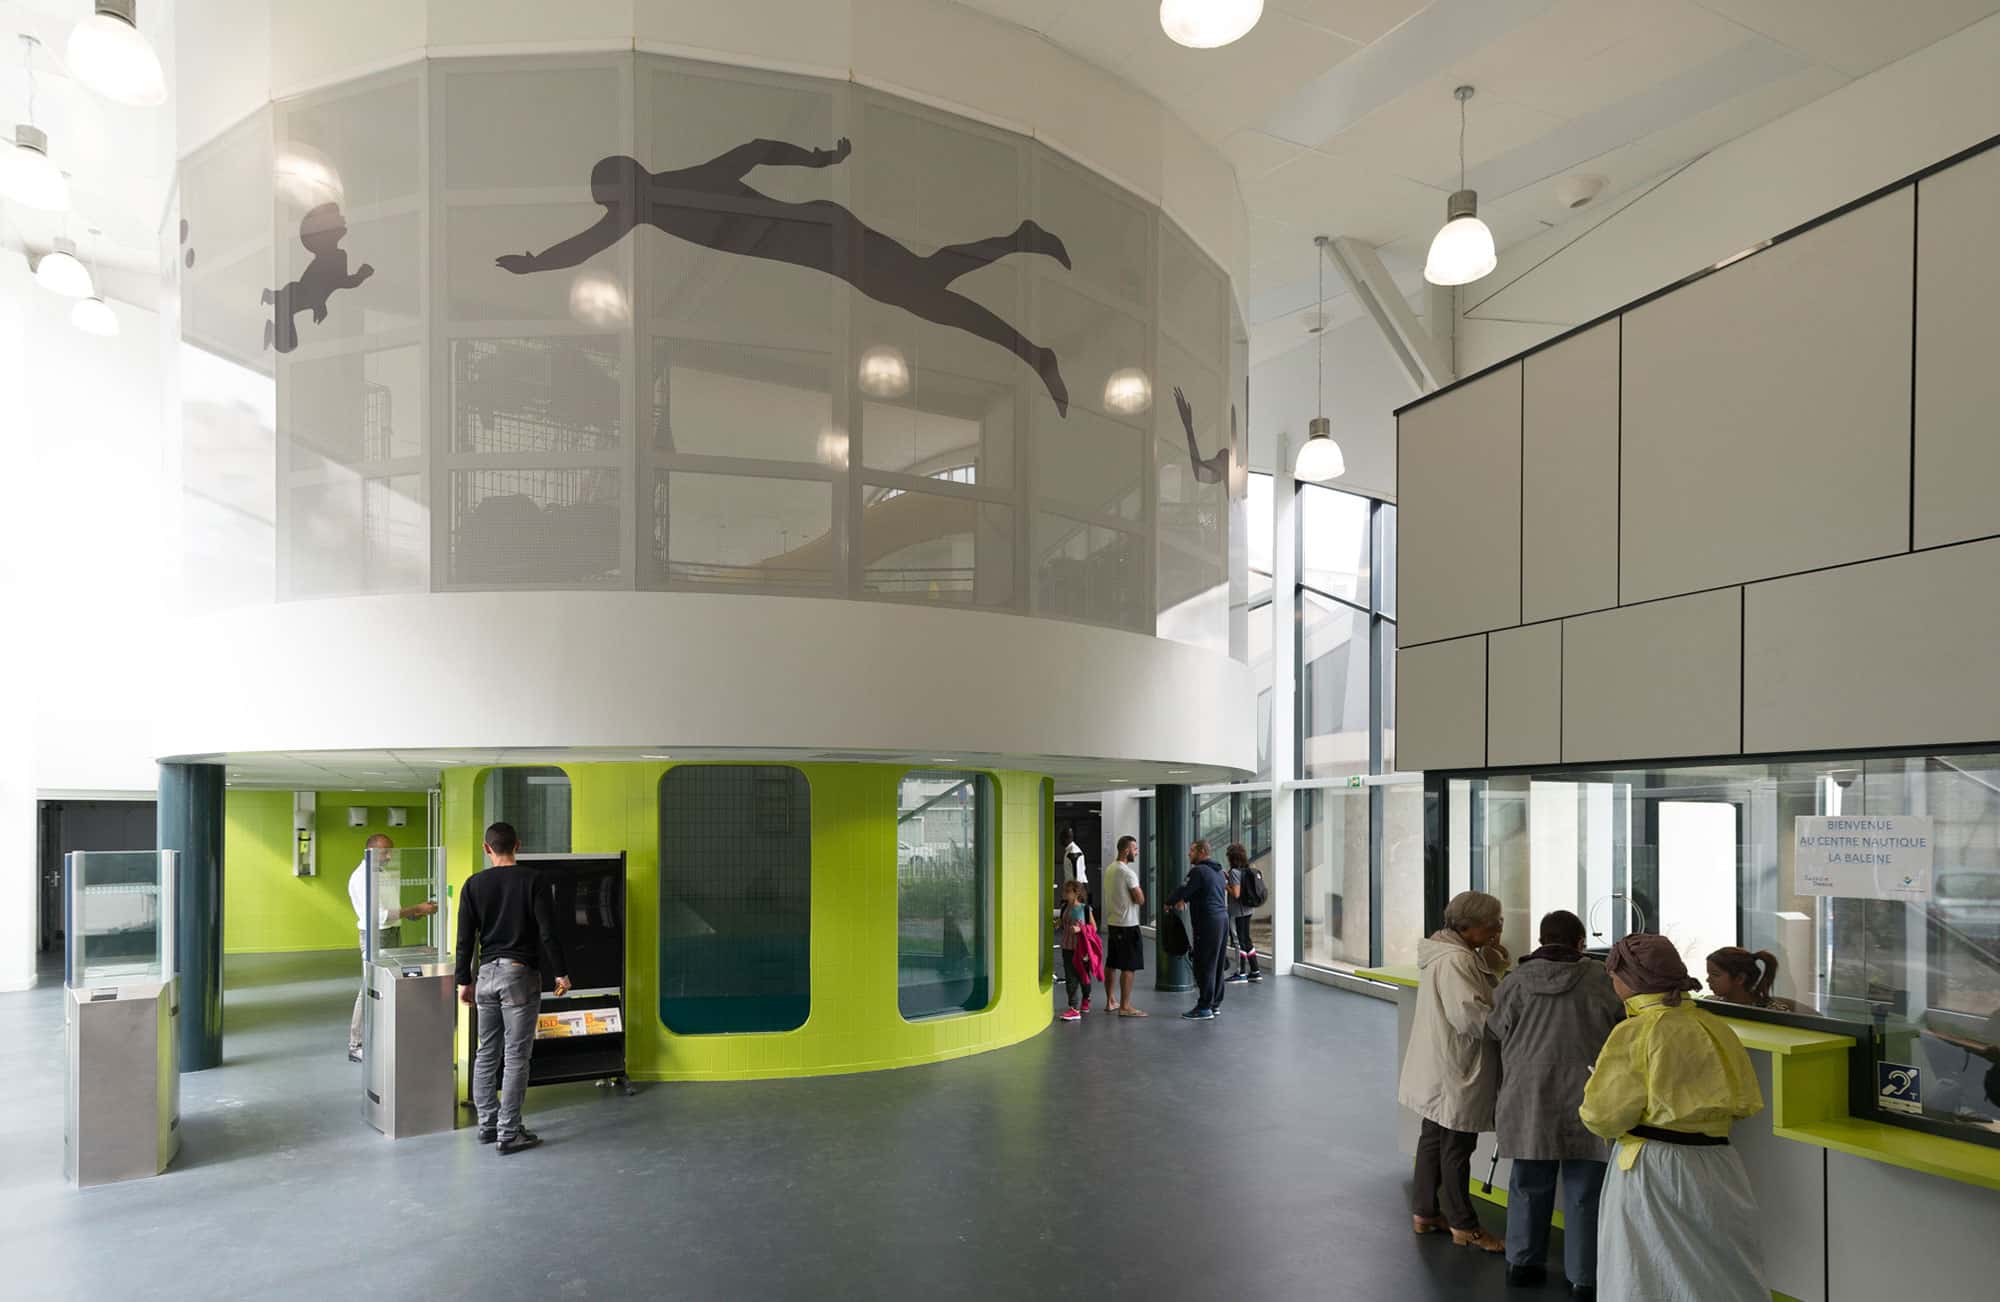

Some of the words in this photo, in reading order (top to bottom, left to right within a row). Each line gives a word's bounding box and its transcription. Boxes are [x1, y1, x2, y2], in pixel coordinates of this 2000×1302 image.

[1827, 820, 1893, 830] BIENVENUE
[1800, 836, 1816, 846] AU
[1817, 836, 1859, 847] CENTRE
[1862, 837, 1927, 848] NAUTIQUE
[1828, 853, 1842, 864] LA
[1844, 853, 1893, 864] BALEINE
